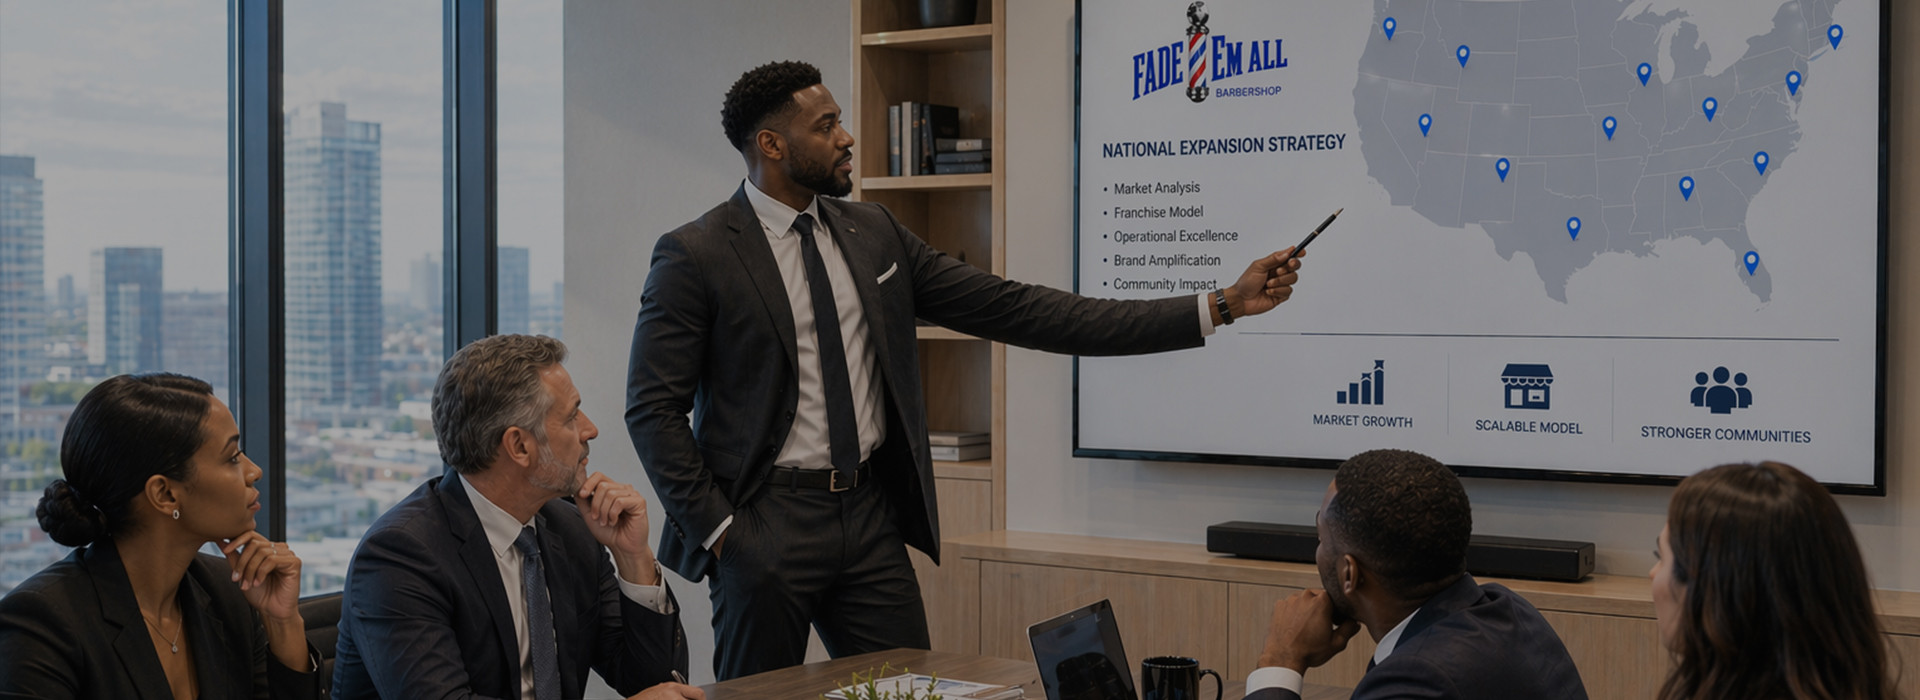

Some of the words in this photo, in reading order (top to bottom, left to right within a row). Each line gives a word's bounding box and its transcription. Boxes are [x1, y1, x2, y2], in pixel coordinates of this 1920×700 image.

[1133, 41, 1183, 100] FADE
[1248, 39, 1287, 73] ALL
[1216, 86, 1281, 97] BARBERSHOP
[1103, 141, 1176, 158] NATIONAL
[1180, 137, 1264, 155] EXPANSION
[1269, 134, 1346, 152] STRATEGY
[1115, 183, 1152, 194] Market
[1155, 181, 1200, 196] Analysis
[1115, 206, 1166, 218] Franchise
[1170, 205, 1203, 217] Model
[1114, 230, 1176, 245] Operational
[1180, 230, 1238, 241] Excellence
[1114, 254, 1145, 266] Brand
[1149, 254, 1221, 268] Amplification
[1114, 278, 1176, 292] Community
[1180, 279, 1217, 291] Impact
[1313, 414, 1359, 426] MARKET
[1362, 416, 1412, 427] GROWTH
[1476, 420, 1536, 433] SCALABLE
[1540, 421, 1583, 434] MODEL
[1642, 426, 1711, 441] STRONGER
[1715, 428, 1811, 443] COMMUNITIES
